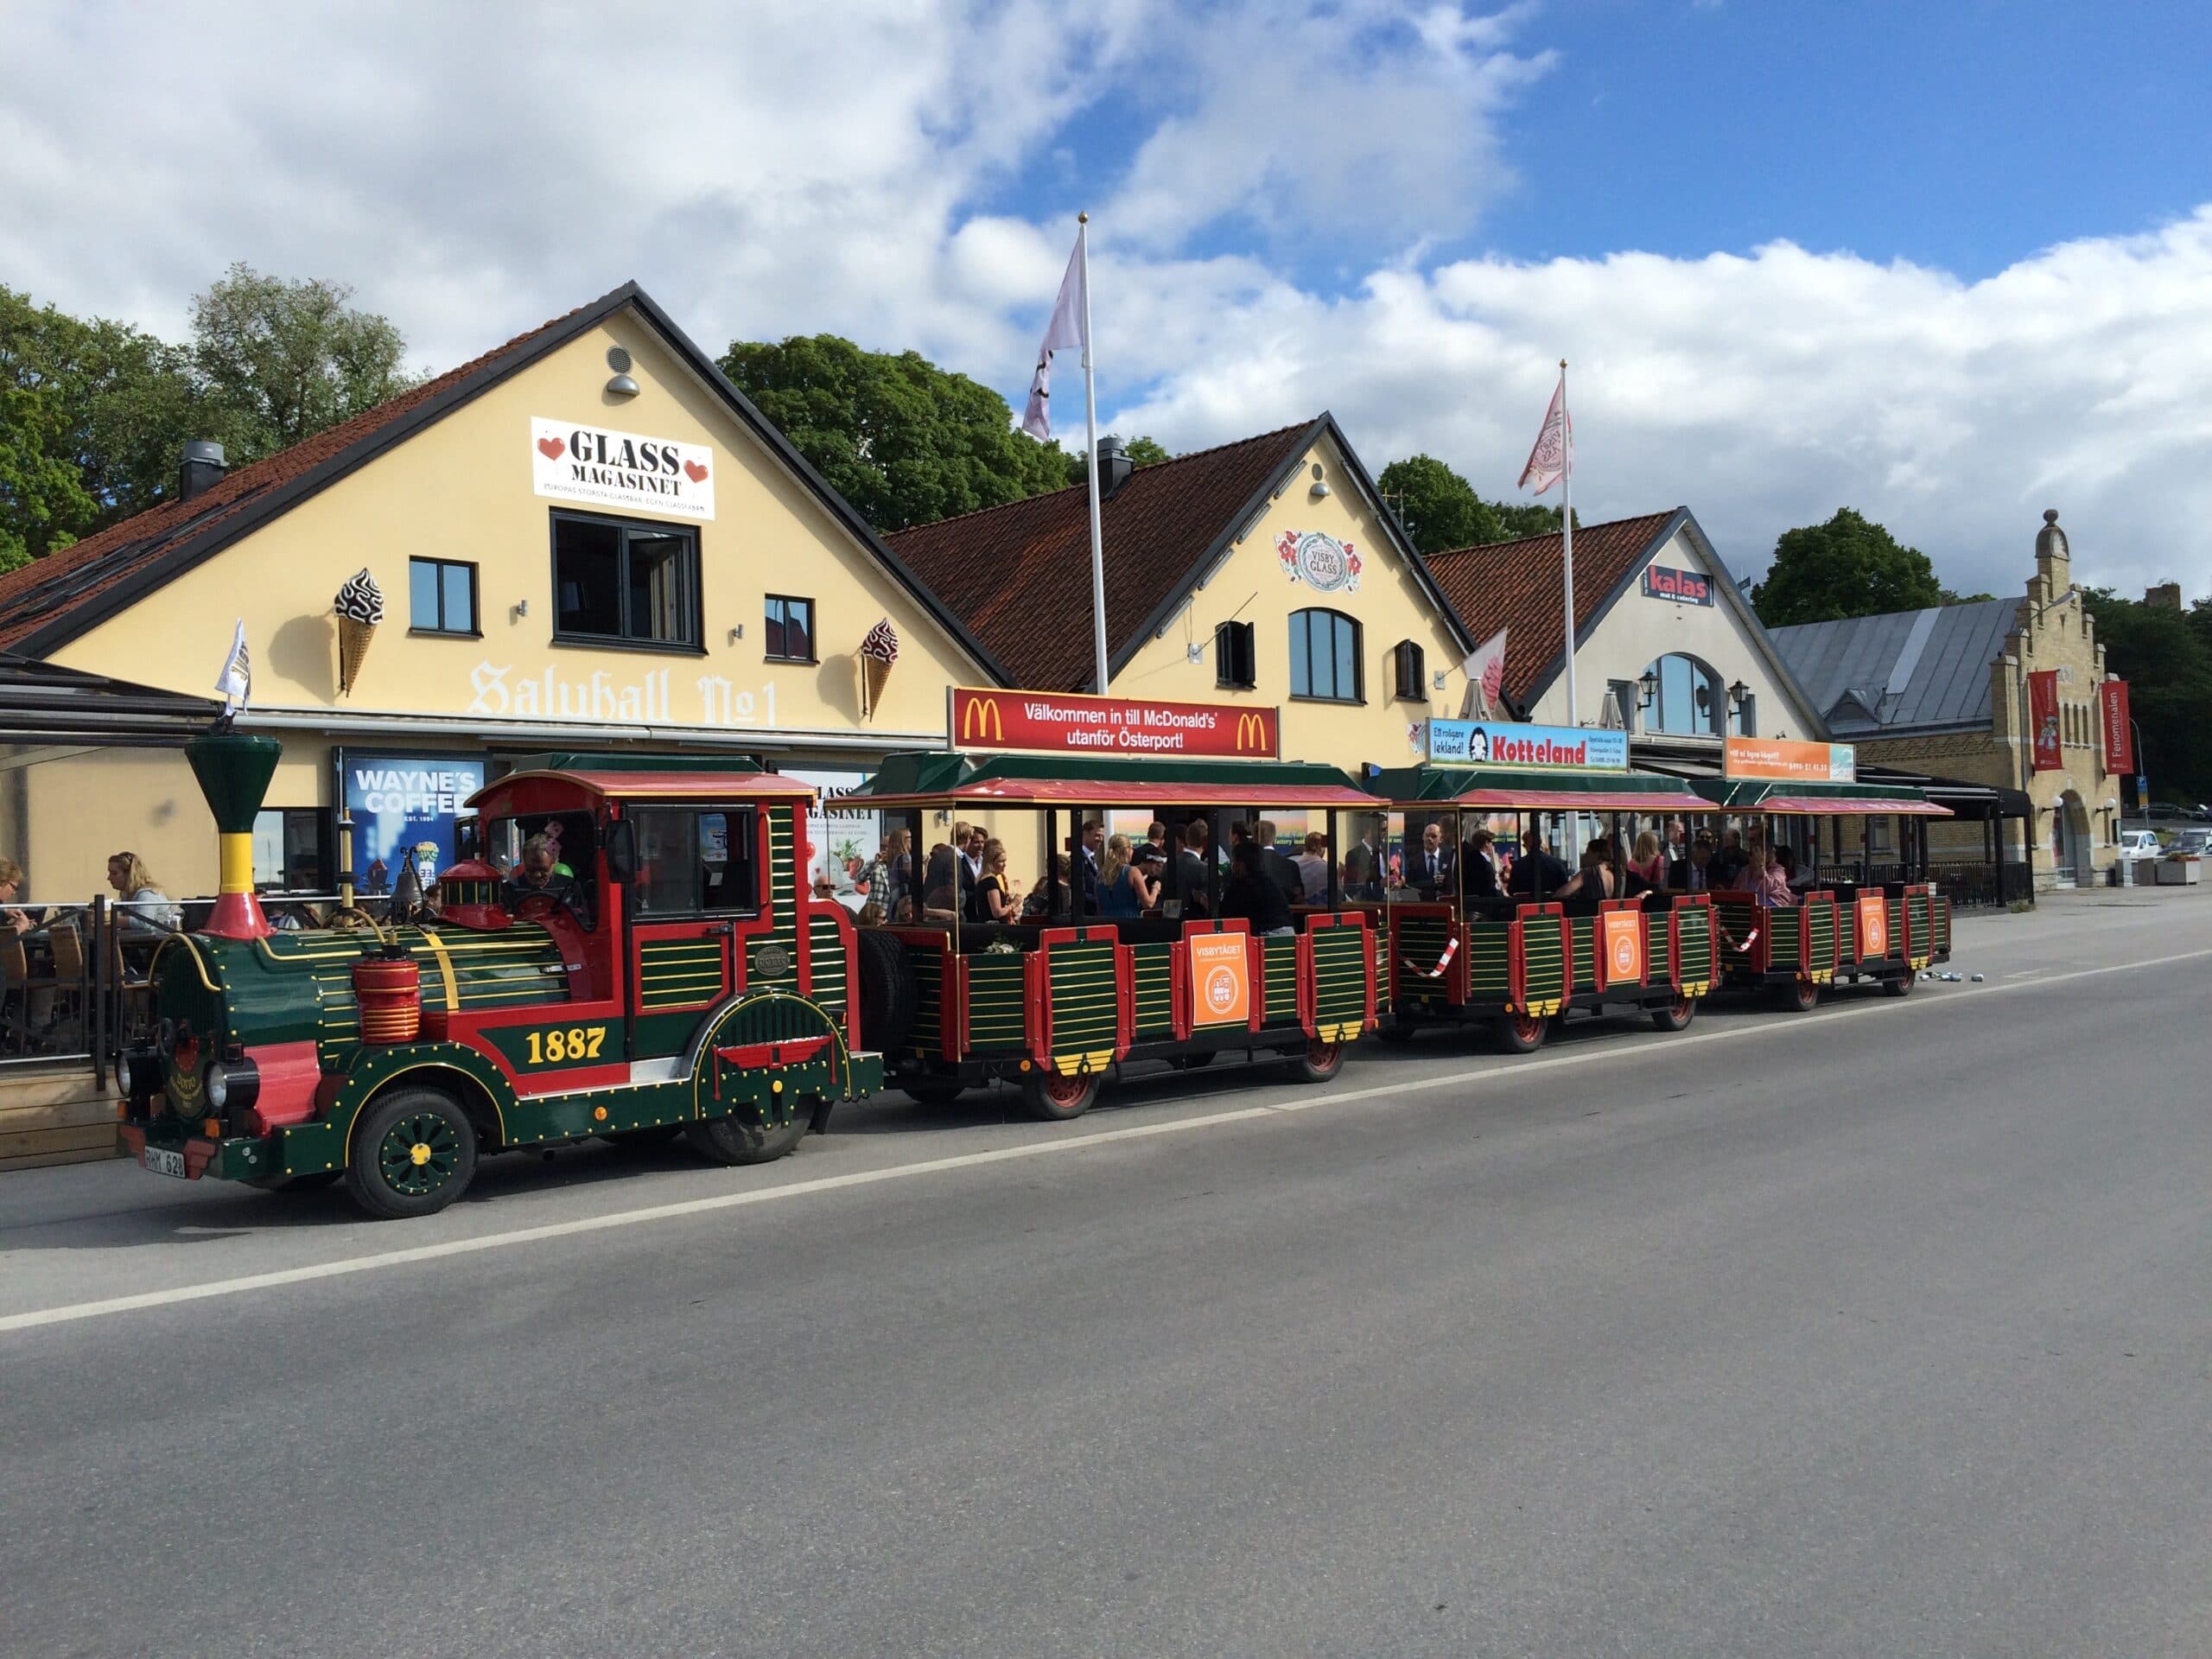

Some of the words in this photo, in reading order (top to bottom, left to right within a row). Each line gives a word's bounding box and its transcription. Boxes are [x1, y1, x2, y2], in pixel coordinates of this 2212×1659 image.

[569, 430, 680, 476] GLASS
[543, 483, 577, 494] EUROPAS
[571, 464, 683, 497] MAGASINET
[1310, 561, 1338, 575] GLASS
[1312, 551, 1335, 564] VISBY
[1649, 565, 1707, 599] kalas
[466, 659, 674, 724] Saluhall
[1024, 702, 1107, 725] Välkommen
[1109, 708, 1122, 725] in
[1125, 709, 1141, 727] till
[1144, 711, 1217, 729] McDonald's
[2108, 692, 2121, 758] Fenomenalen
[1066, 729, 1115, 747] utanför
[1119, 726, 1184, 751] Österport!
[1433, 741, 1464, 754] lekland!
[1492, 735, 1586, 765] Kotteland
[355, 770, 476, 792] WAYNE'S
[816, 785, 854, 800] LASS
[365, 791, 469, 814] COFFEE
[1197, 944, 1242, 957] VISBYTÅGET
[525, 1027, 607, 1065] 1887
